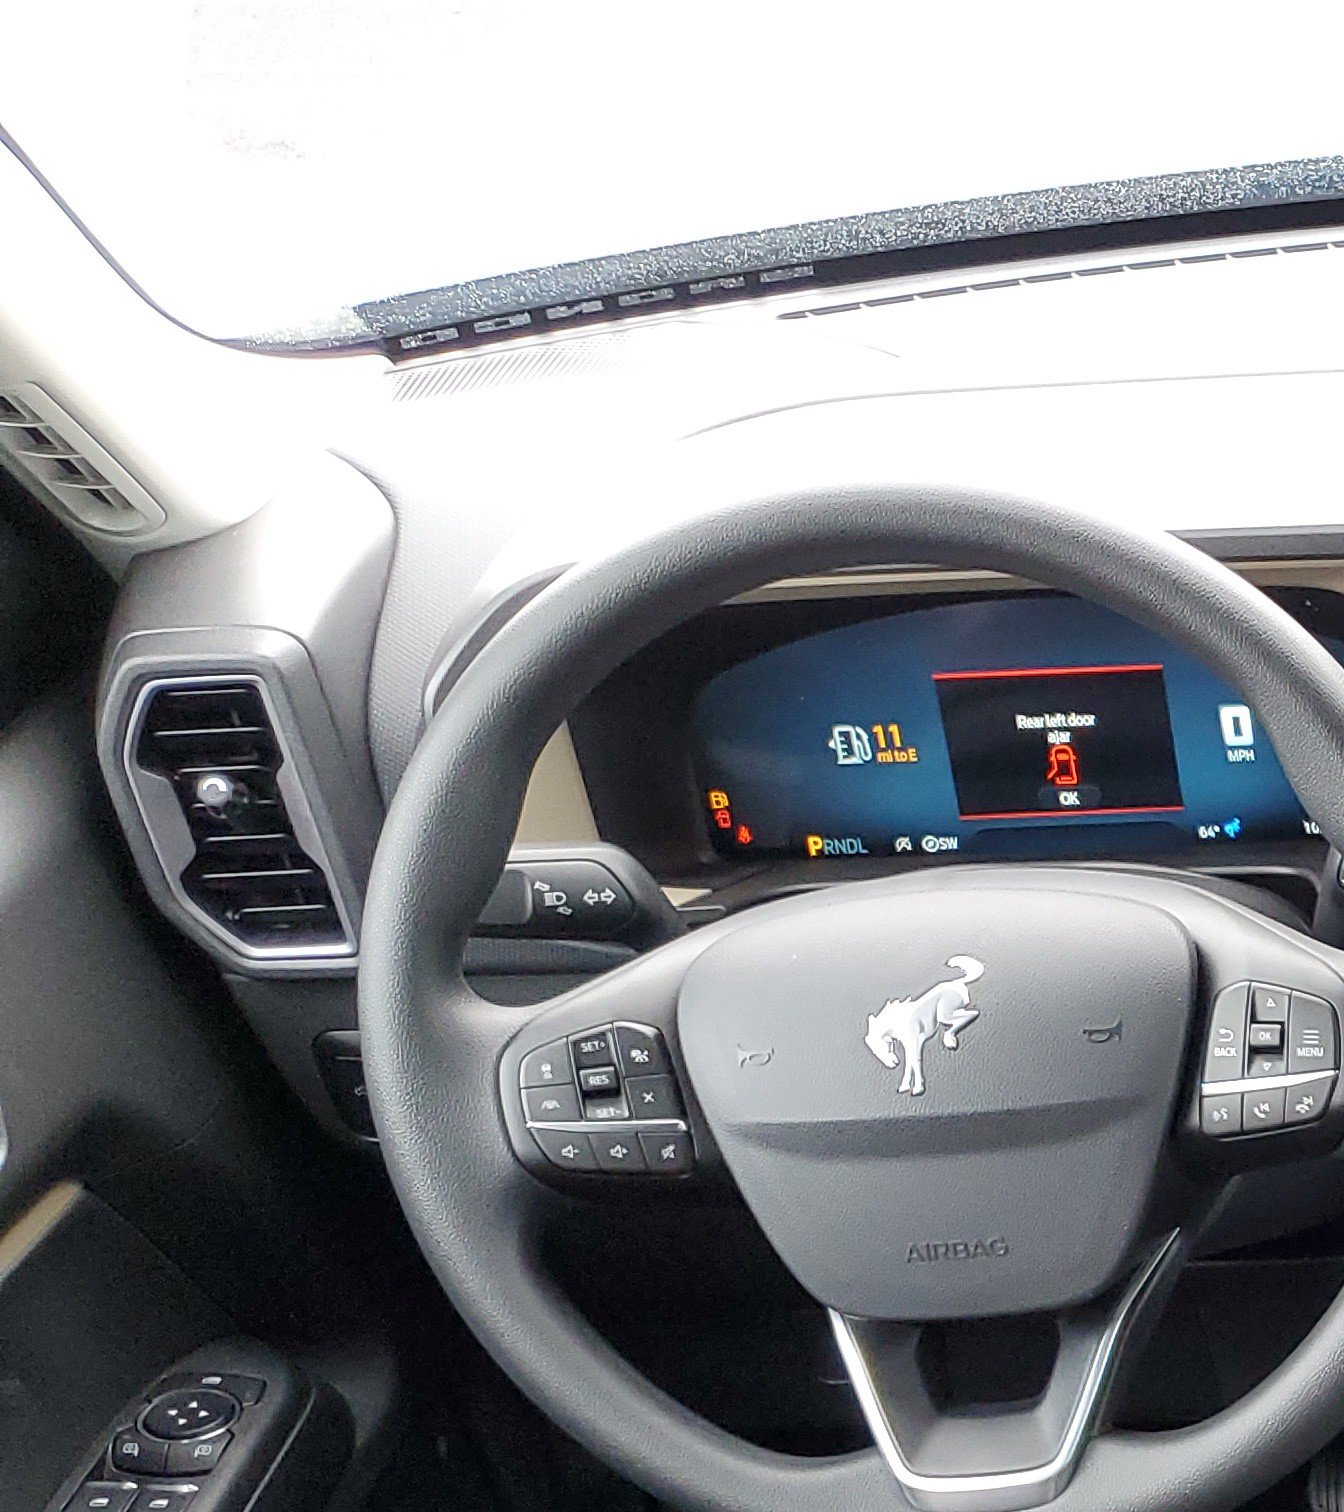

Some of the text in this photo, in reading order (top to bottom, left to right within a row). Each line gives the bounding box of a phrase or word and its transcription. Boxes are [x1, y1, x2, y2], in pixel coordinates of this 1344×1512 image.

[1015, 711, 1096, 730] Rear left door
[1219, 704, 1254, 746] 0
[872, 723, 902, 748] 11
[1047, 730, 1071, 744] ajar
[876, 747, 918, 763] mi to E
[1227, 749, 1255, 763] MPH
[1059, 791, 1080, 806] OK
[939, 836, 959, 850] SW
[1259, 1031, 1271, 1041] OK
[1214, 1047, 1237, 1057] BACK
[1297, 1047, 1323, 1057] MENU
[588, 1075, 610, 1085] RES
[906, 1236, 1010, 1263] AIRBAG
